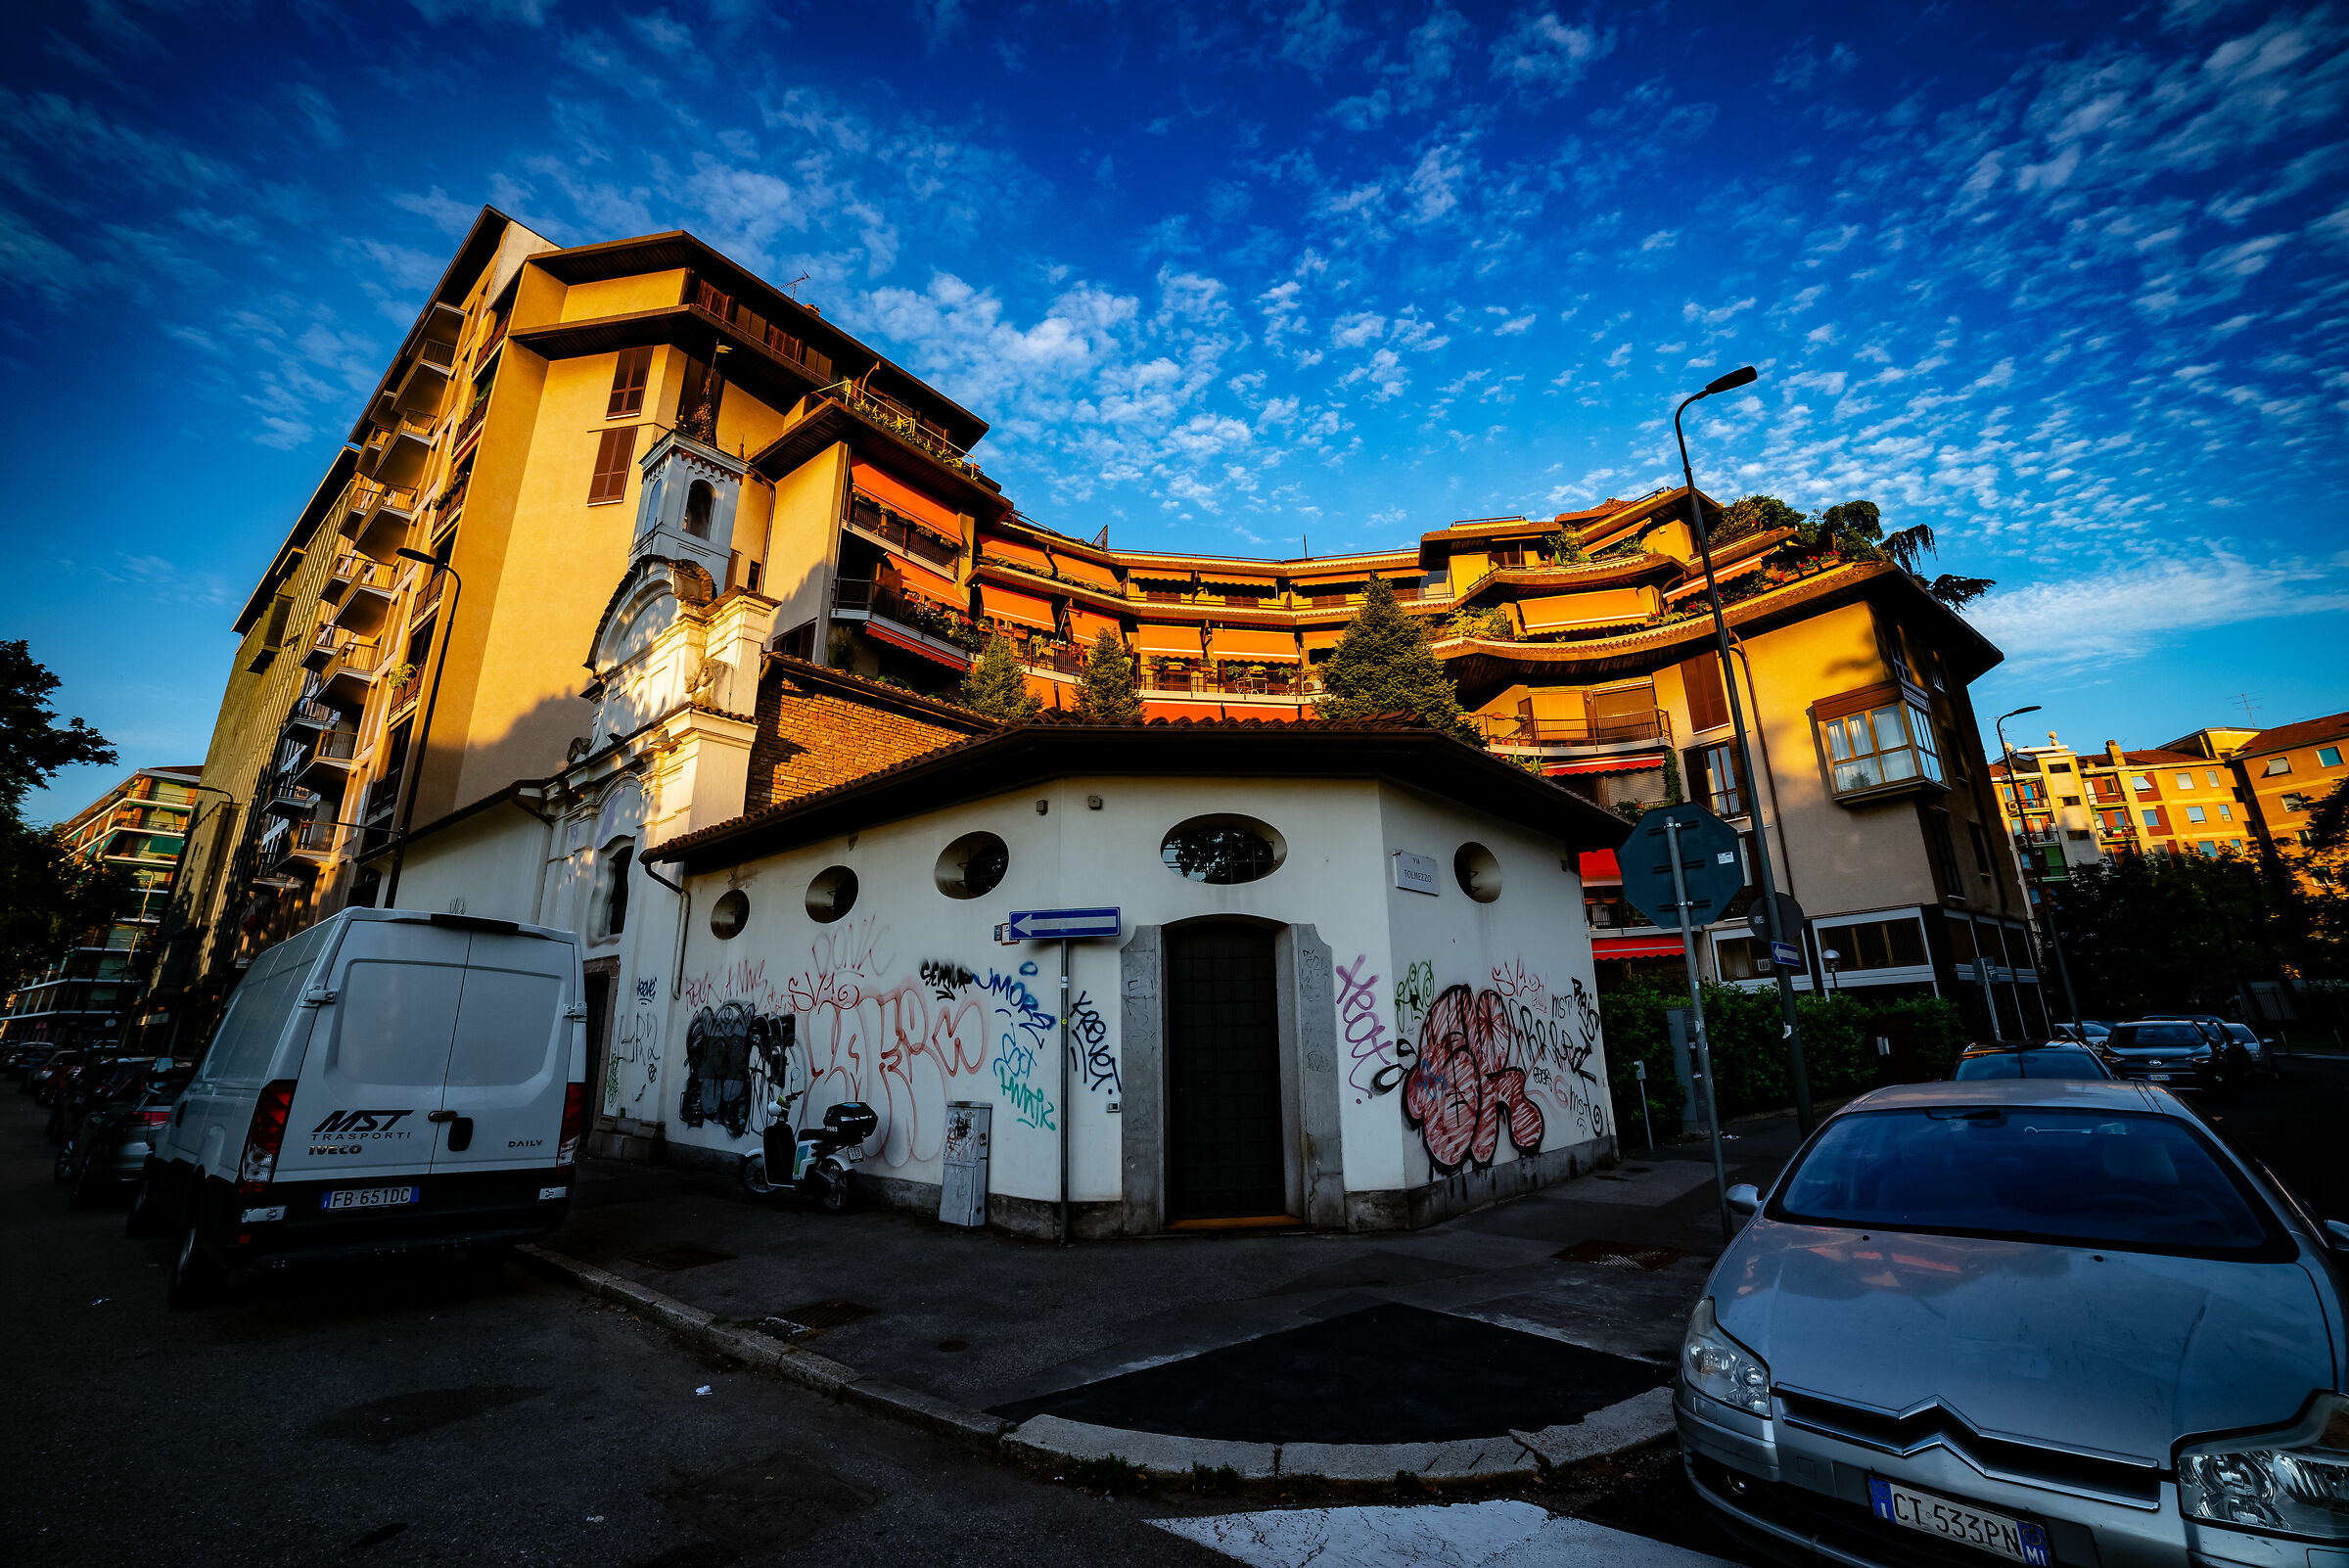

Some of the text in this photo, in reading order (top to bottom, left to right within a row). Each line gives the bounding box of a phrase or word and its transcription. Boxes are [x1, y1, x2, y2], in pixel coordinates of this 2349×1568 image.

[1404, 869, 1432, 883] TOLMEZZO
[312, 1110, 415, 1132] MST
[311, 1131, 411, 1141] TRASPORTI
[308, 1144, 362, 1155] IVECO
[508, 1139, 543, 1148] DAILY
[333, 1191, 353, 1207] FB
[359, 1187, 410, 1205] 651DC
[1893, 1493, 1921, 1524] CT
[1933, 1504, 2023, 1557] 533PN
[2025, 1545, 2048, 1567] MI
